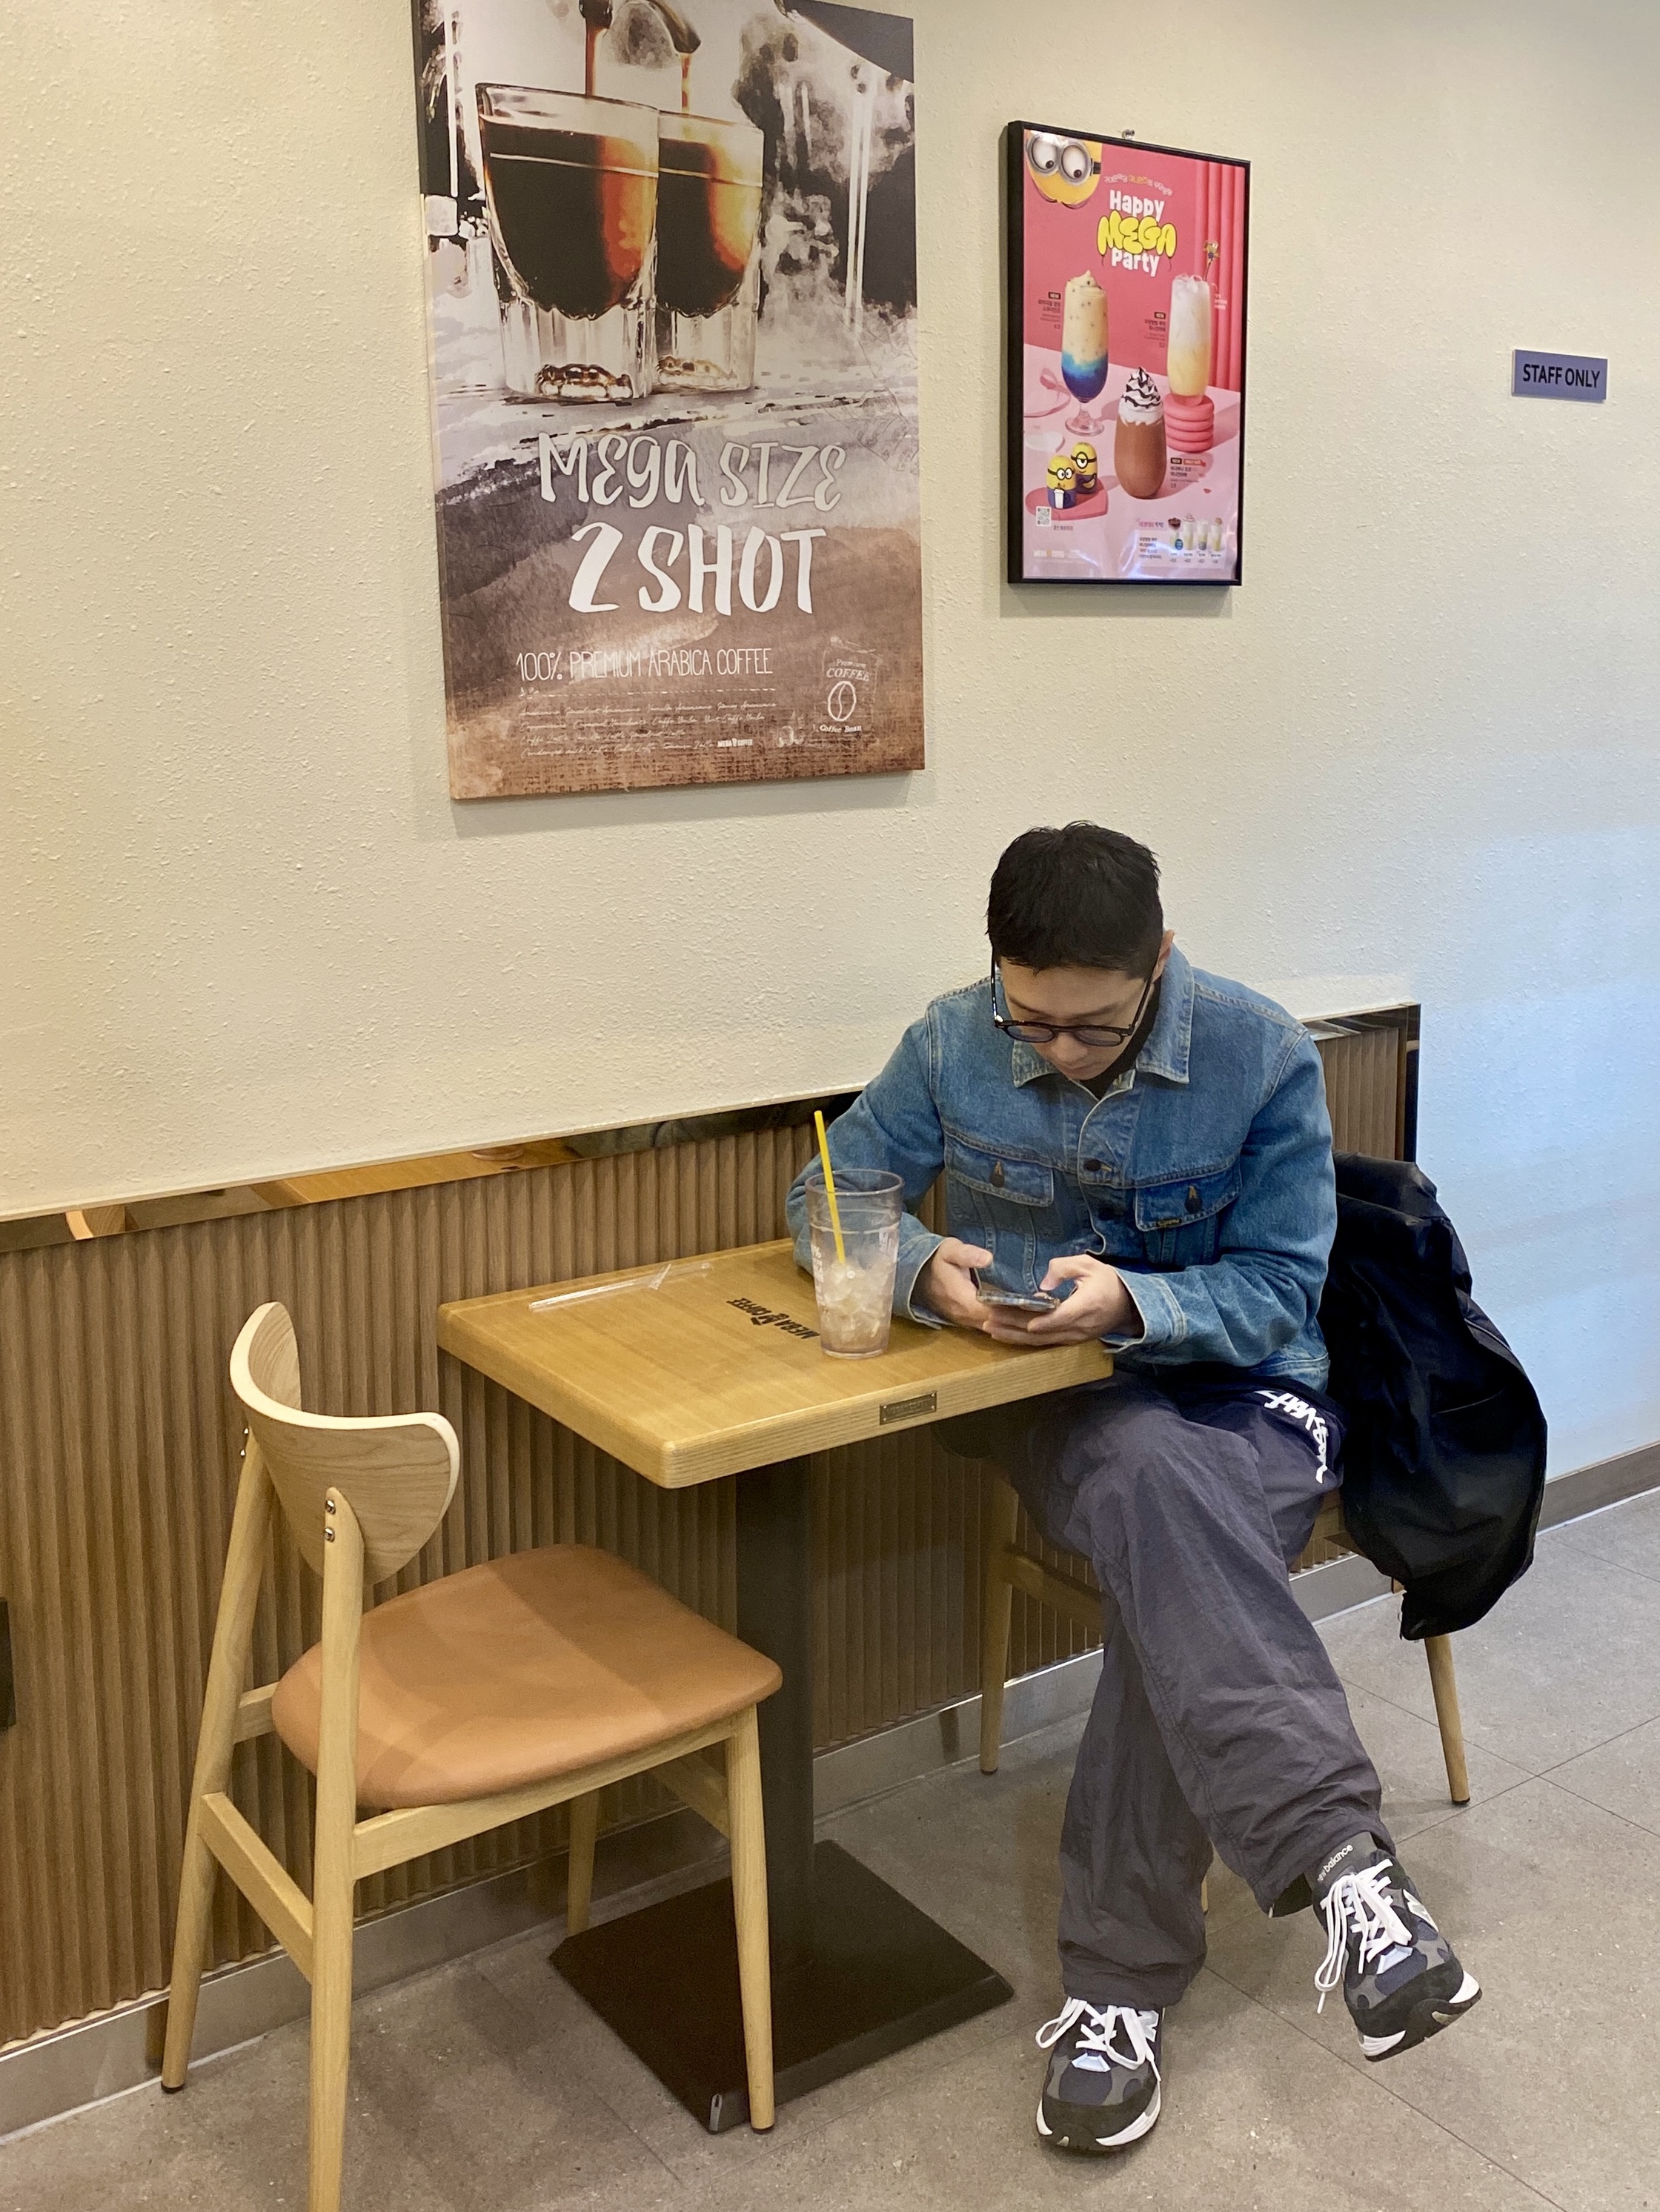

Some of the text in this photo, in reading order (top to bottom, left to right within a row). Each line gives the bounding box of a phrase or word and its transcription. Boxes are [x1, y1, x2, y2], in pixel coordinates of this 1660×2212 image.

[1109, 190, 1165, 222] Happy
[1098, 210, 1178, 258] MEGA
[1112, 247, 1160, 277] Party
[1523, 363, 1601, 388] STAFF ONLY
[719, 441, 846, 511] SIZE
[568, 522, 827, 617] 2 SHOT
[516, 648, 774, 681] 100% PREMIUM ARABICA COFFEE
[826, 668, 870, 681] COFFEE
[820, 724, 842, 733] Coffee
[1323, 1844, 1353, 1873] balance
